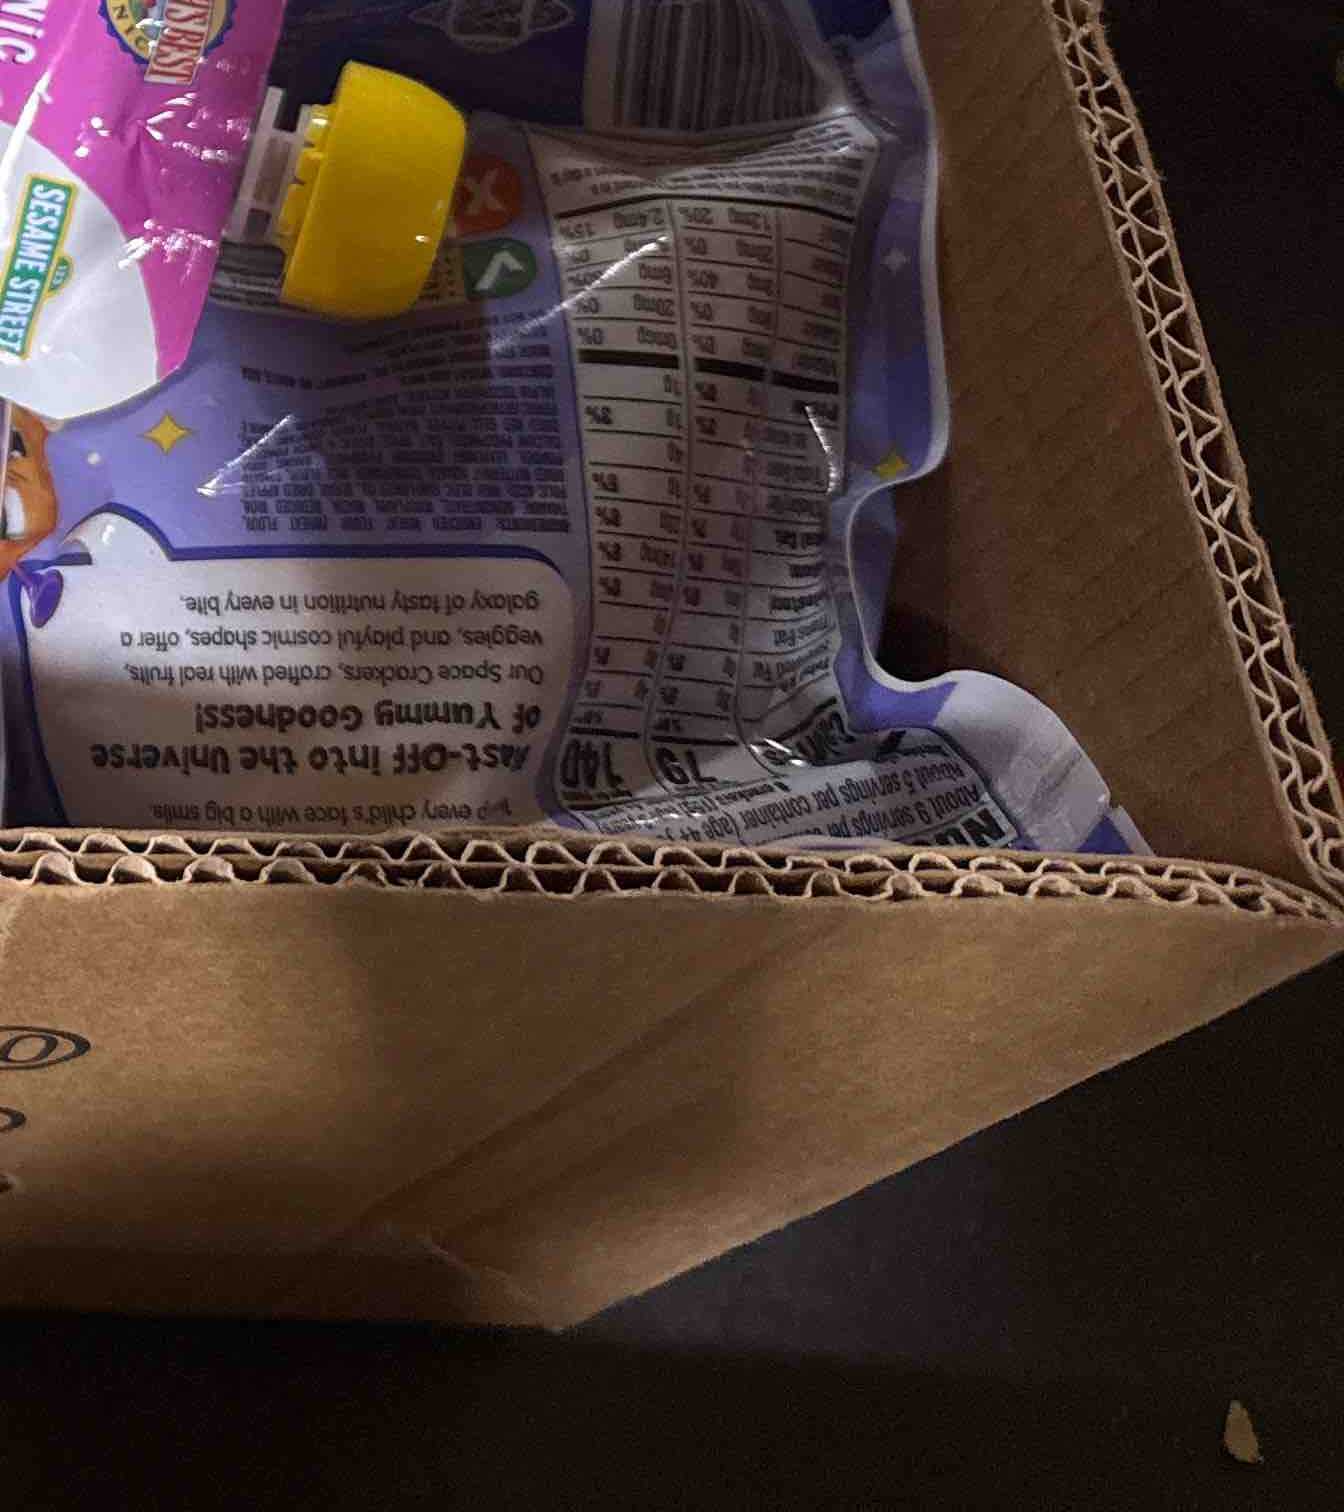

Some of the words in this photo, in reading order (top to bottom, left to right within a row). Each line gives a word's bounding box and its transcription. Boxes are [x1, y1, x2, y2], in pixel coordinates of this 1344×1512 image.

[146, 23, 209, 84] BEST
[22, 182, 67, 273] SESAME
[224, 590, 273, 612] every
[302, 594, 384, 613] nutrition
[193, 702, 361, 733] Goodness!
[374, 698, 500, 731] Yummy
[89, 742, 229, 774] Universe
[239, 744, 297, 775] the
[307, 744, 381, 775] into
